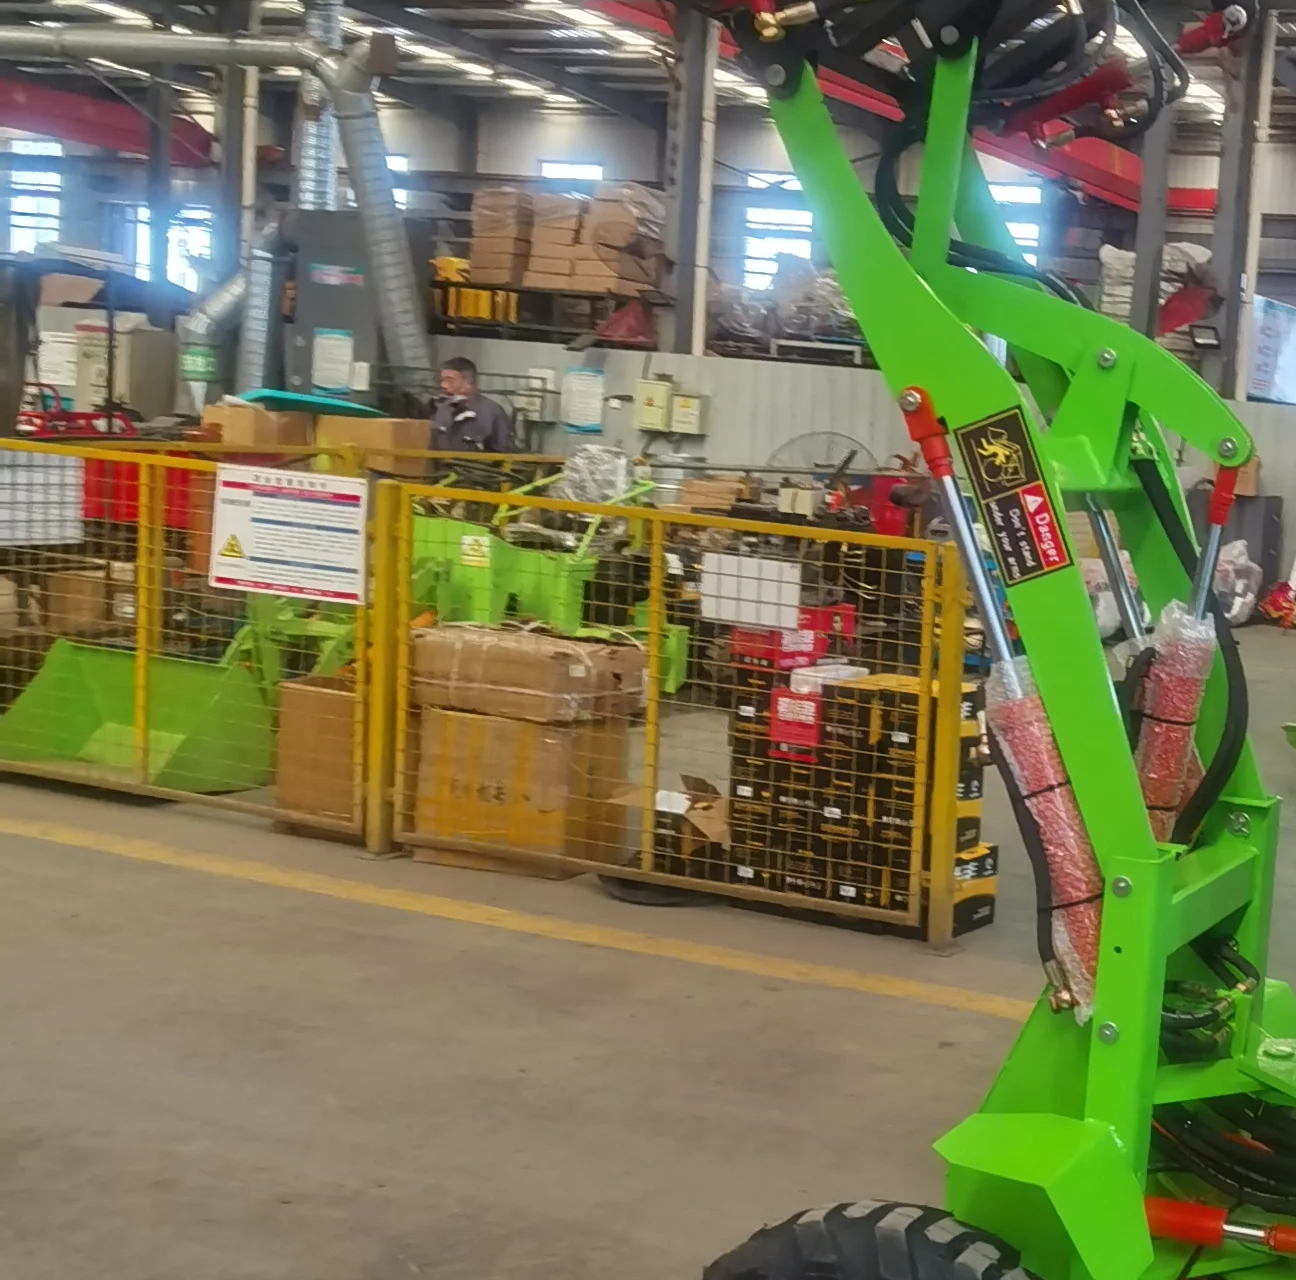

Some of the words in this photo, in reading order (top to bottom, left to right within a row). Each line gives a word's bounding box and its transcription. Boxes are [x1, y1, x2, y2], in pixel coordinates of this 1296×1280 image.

[997, 532, 1012, 552] your
[1008, 508, 1027, 537] Don't
[1018, 538, 1037, 567] stand
[1035, 513, 1059, 562] Danger
